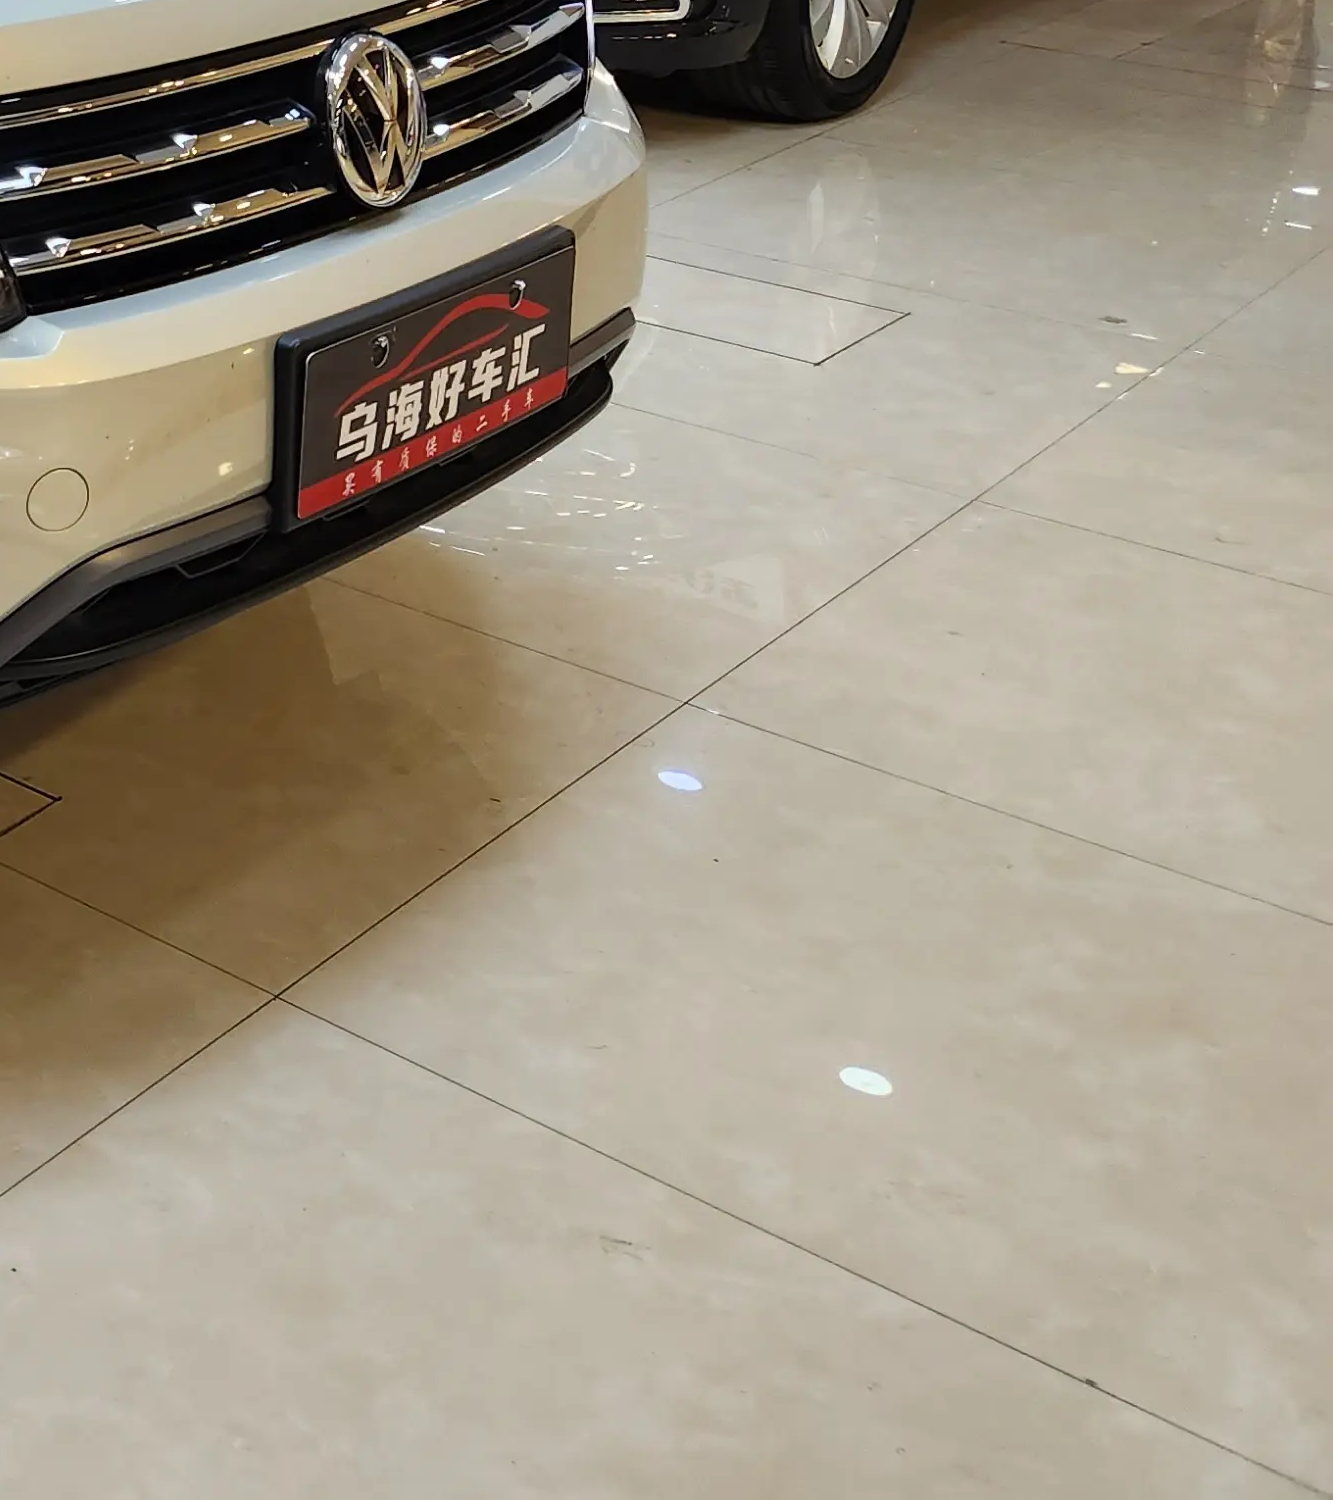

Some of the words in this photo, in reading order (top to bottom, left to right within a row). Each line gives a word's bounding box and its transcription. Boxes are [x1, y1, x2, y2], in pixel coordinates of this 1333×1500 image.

[336, 323, 546, 463] 乌海好车汇
